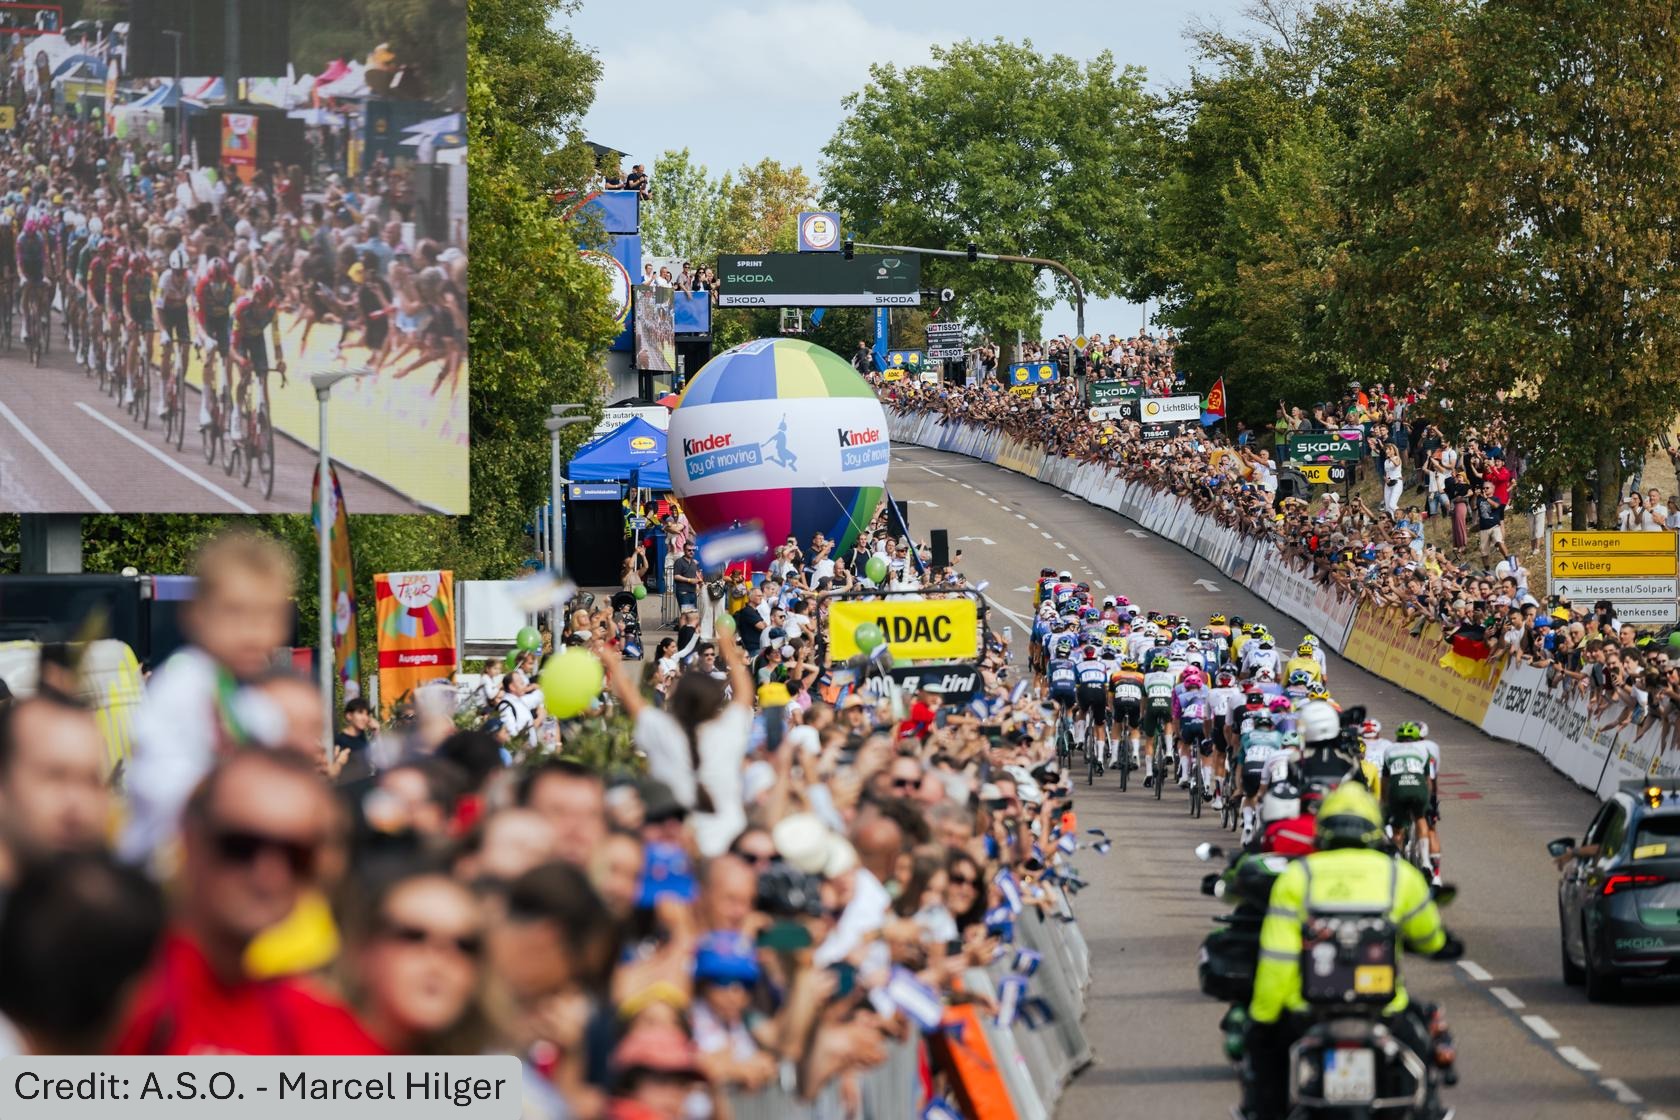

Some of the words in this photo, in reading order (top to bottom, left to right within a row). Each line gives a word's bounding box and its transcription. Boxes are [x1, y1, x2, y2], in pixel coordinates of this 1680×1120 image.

[1122, 406, 1131, 416] 50
[1163, 403, 1199, 413] LichtBlick
[689, 461, 705, 475] Joy
[705, 455, 715, 470] of
[717, 448, 757, 468] moving
[845, 452, 860, 467] Joy
[863, 449, 872, 463] of
[1331, 468, 1345, 479] 100
[1571, 538, 1620, 548] Ellwangen
[1572, 561, 1611, 571] Vellberg
[403, 576, 428, 584] EXPO
[1586, 585, 1673, 594] Hessental/Solpark
[875, 615, 952, 643] ADAC
[398, 653, 438, 665] Ausgang
